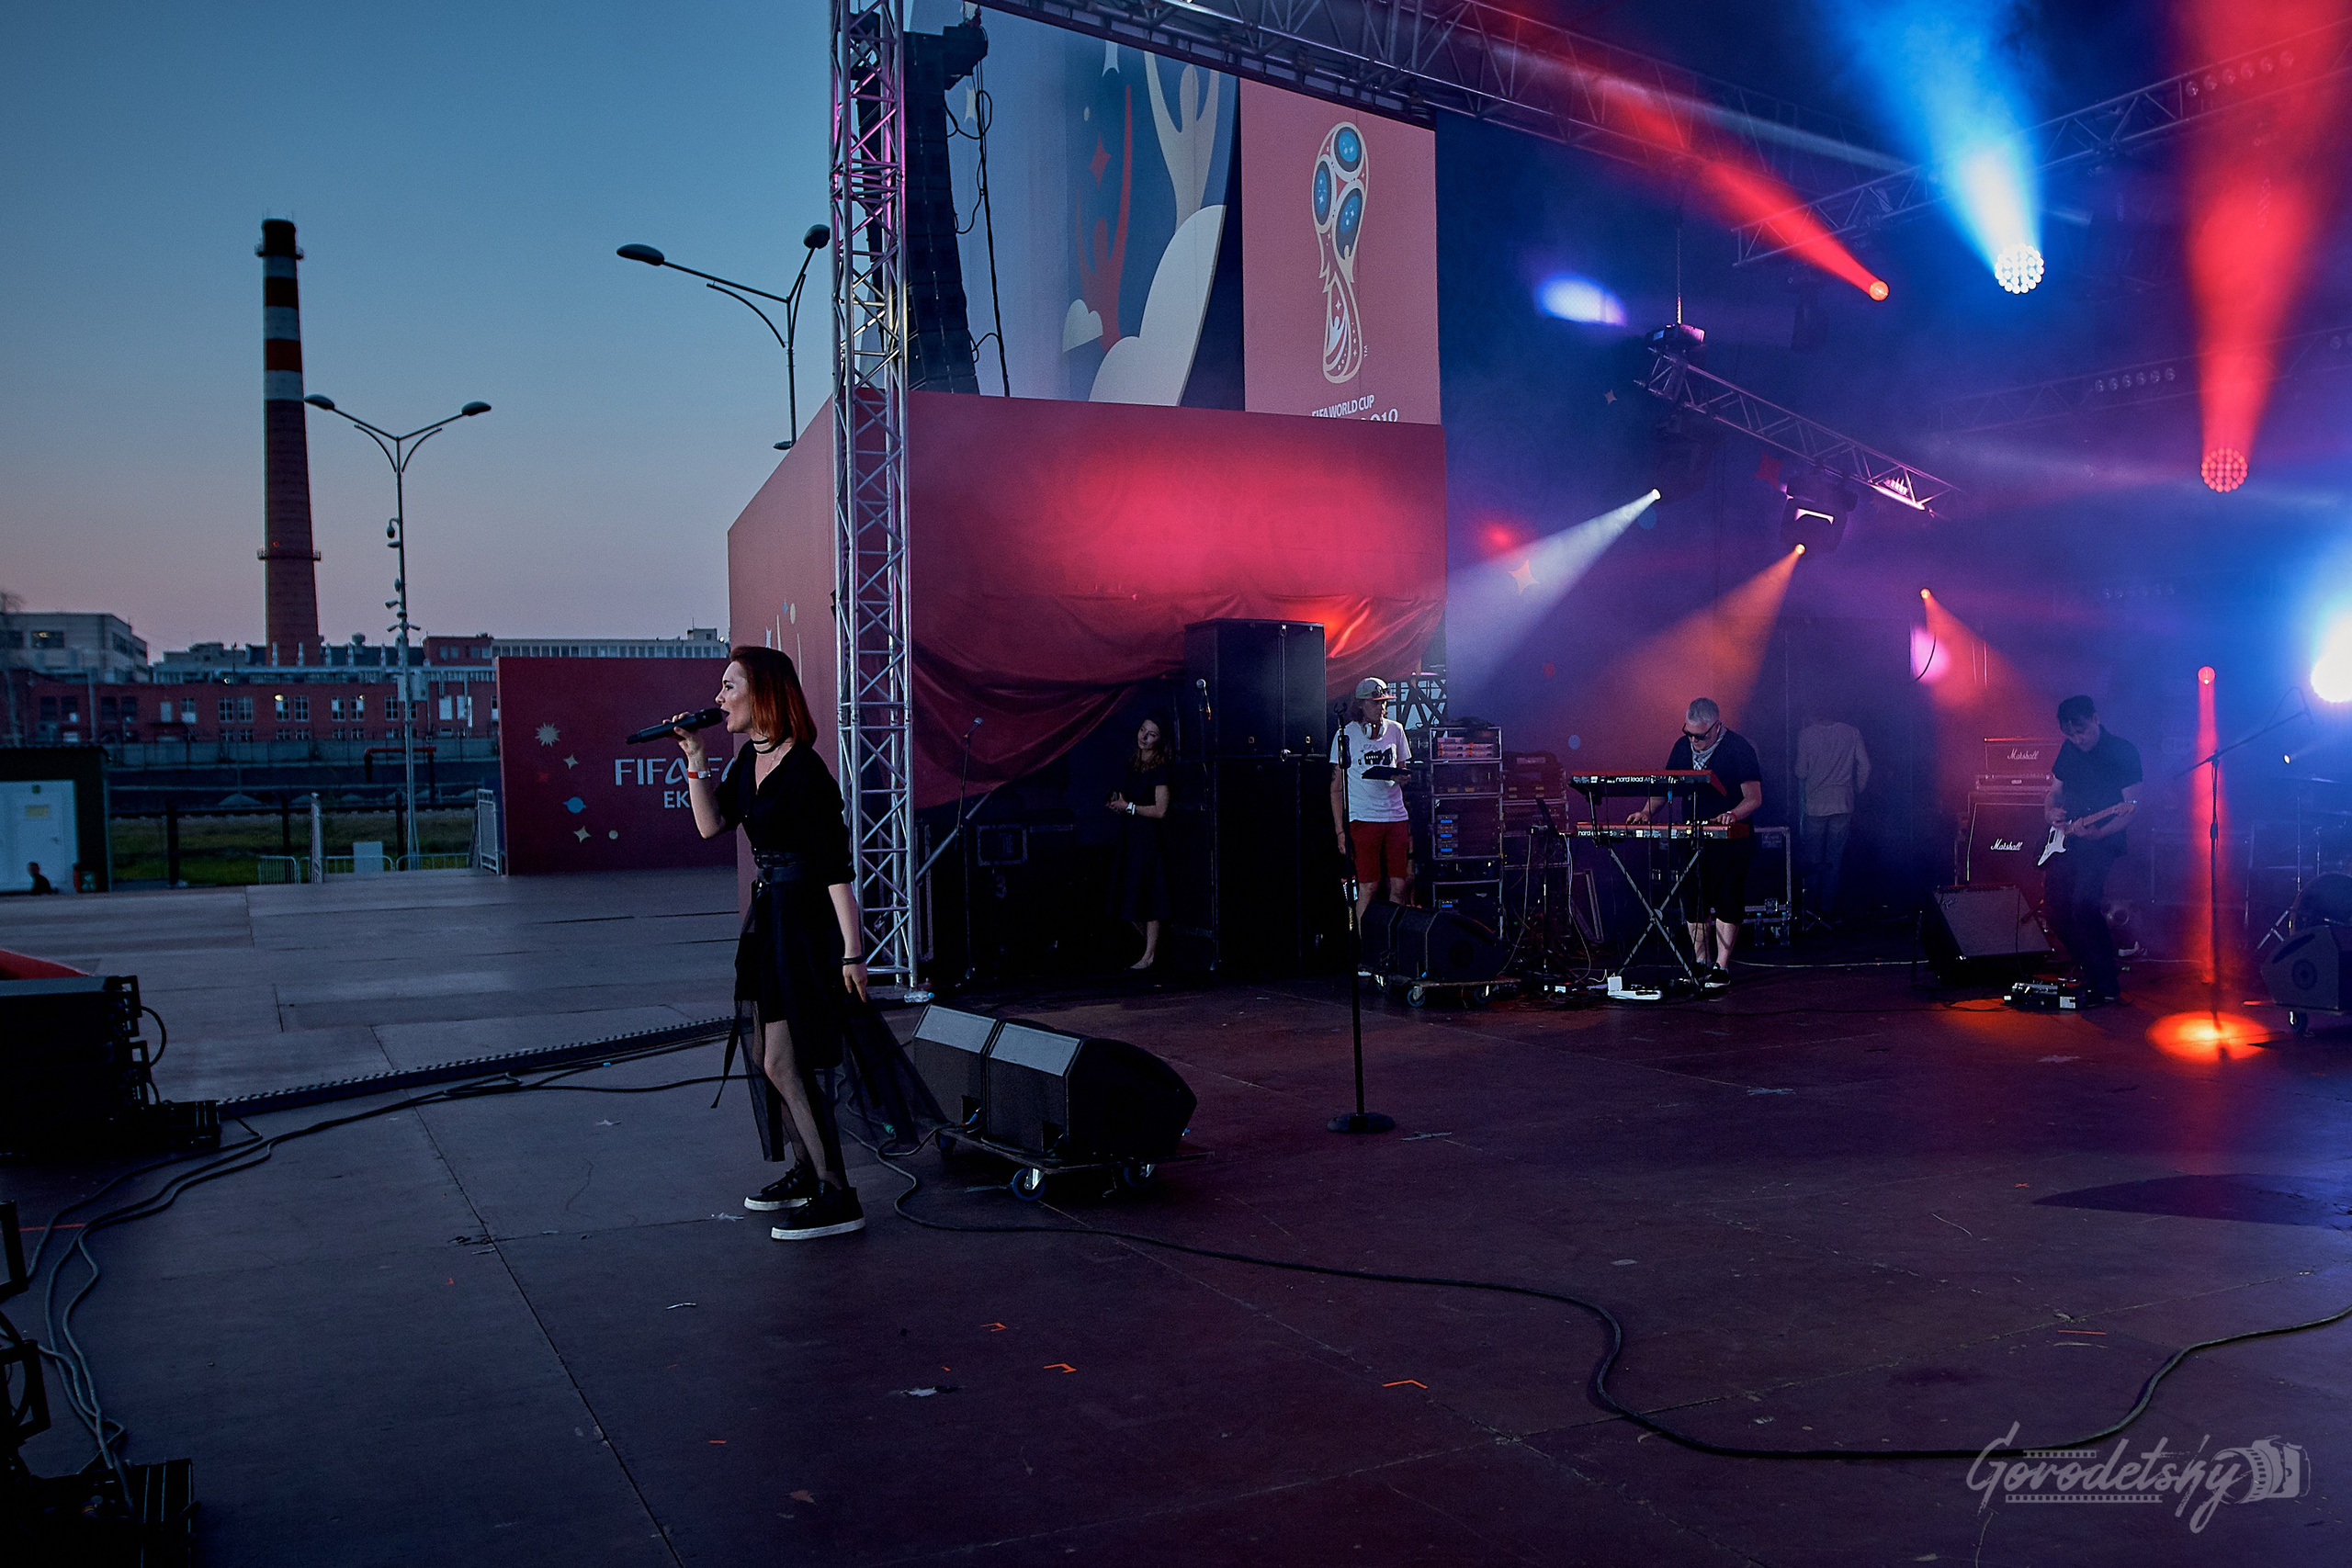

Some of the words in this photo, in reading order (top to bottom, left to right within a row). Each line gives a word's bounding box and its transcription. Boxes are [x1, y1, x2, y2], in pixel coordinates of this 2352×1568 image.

[1329, 400, 1358, 417] WORLD
[1359, 394, 1374, 411] CUP
[2007, 748, 2040, 760] Marshall
[615, 757, 689, 785] FIFA
[1990, 838, 2023, 852] Marshall
